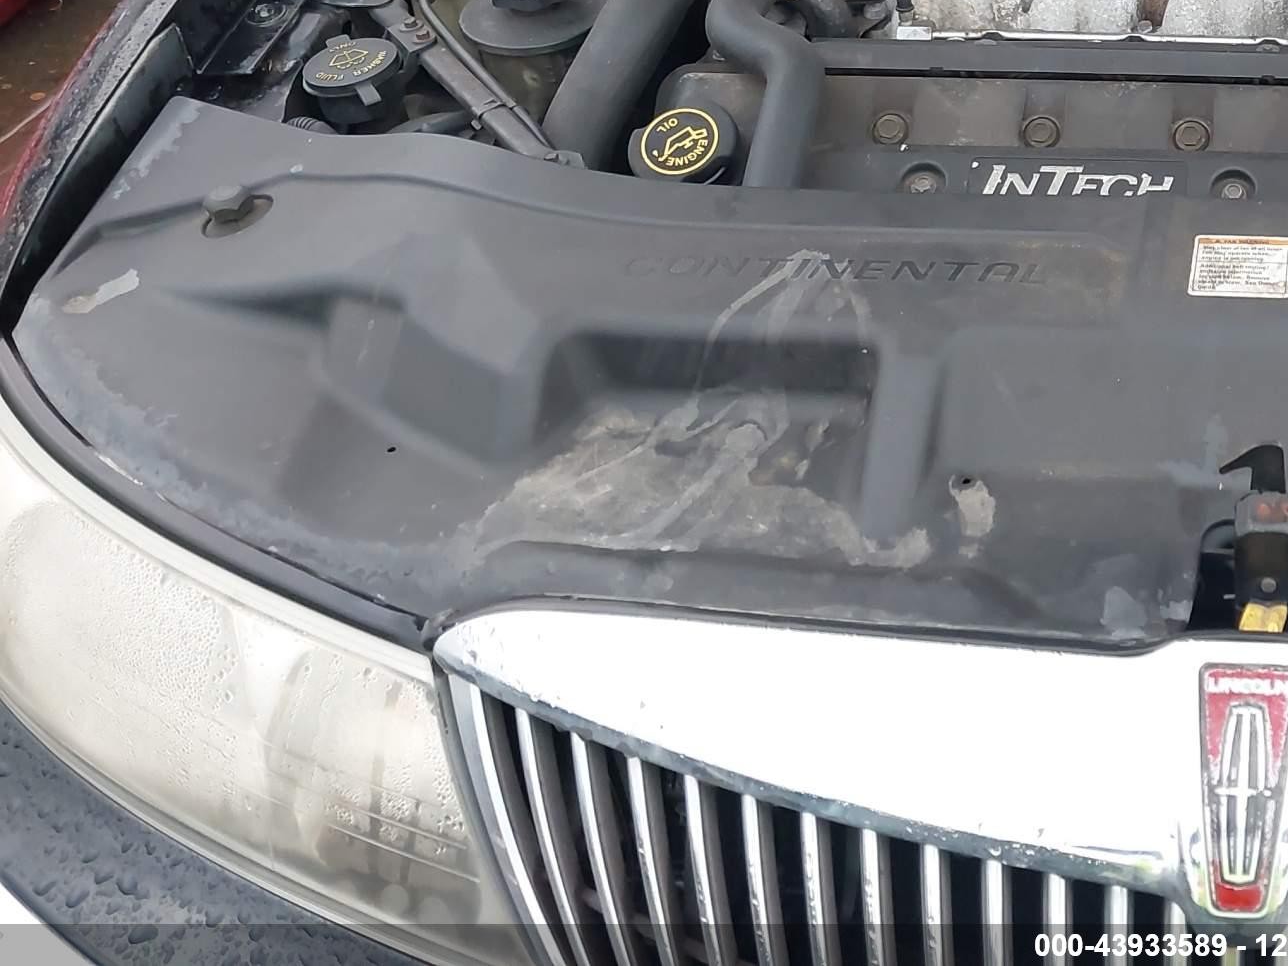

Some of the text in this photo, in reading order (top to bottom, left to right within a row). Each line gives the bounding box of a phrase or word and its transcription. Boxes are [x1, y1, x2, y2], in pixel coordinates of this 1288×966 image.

[316, 50, 387, 81] WASHER FLUID
[656, 117, 678, 132] OIL
[666, 139, 708, 166] ENGINE
[625, 255, 1050, 285] CONTINENTAL
